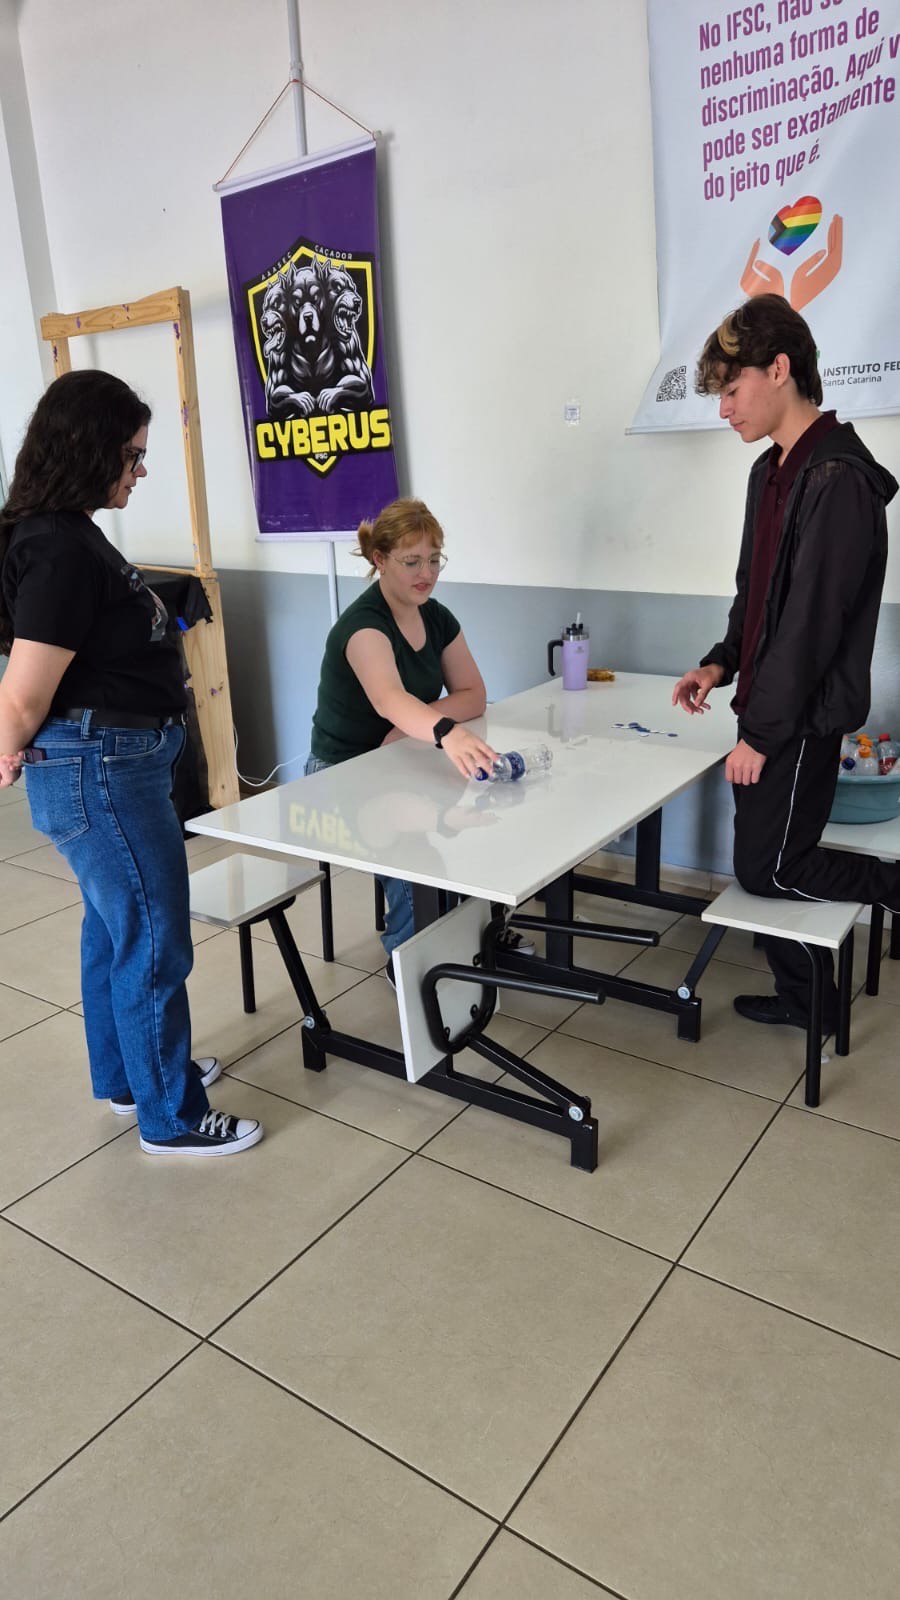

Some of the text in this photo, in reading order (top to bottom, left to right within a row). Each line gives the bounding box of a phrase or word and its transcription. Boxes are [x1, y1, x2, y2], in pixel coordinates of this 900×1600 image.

[699, 22, 721, 51] No
[726, 3, 771, 42] IFSC,
[700, 7, 879, 89] nenhuma forma de
[702, 64, 839, 127] discriminação.
[845, 36, 885, 82] Aqui
[703, 75, 896, 172] pode ser exatamente
[704, 172, 724, 200] do
[730, 161, 770, 202] jeito
[775, 149, 806, 186] que
[314, 244, 353, 260] CAÇADOR
[823, 362, 881, 377] INSTITUTO
[823, 375, 882, 387] Santa Catarina
[256, 408, 391, 459] CYBERUS
